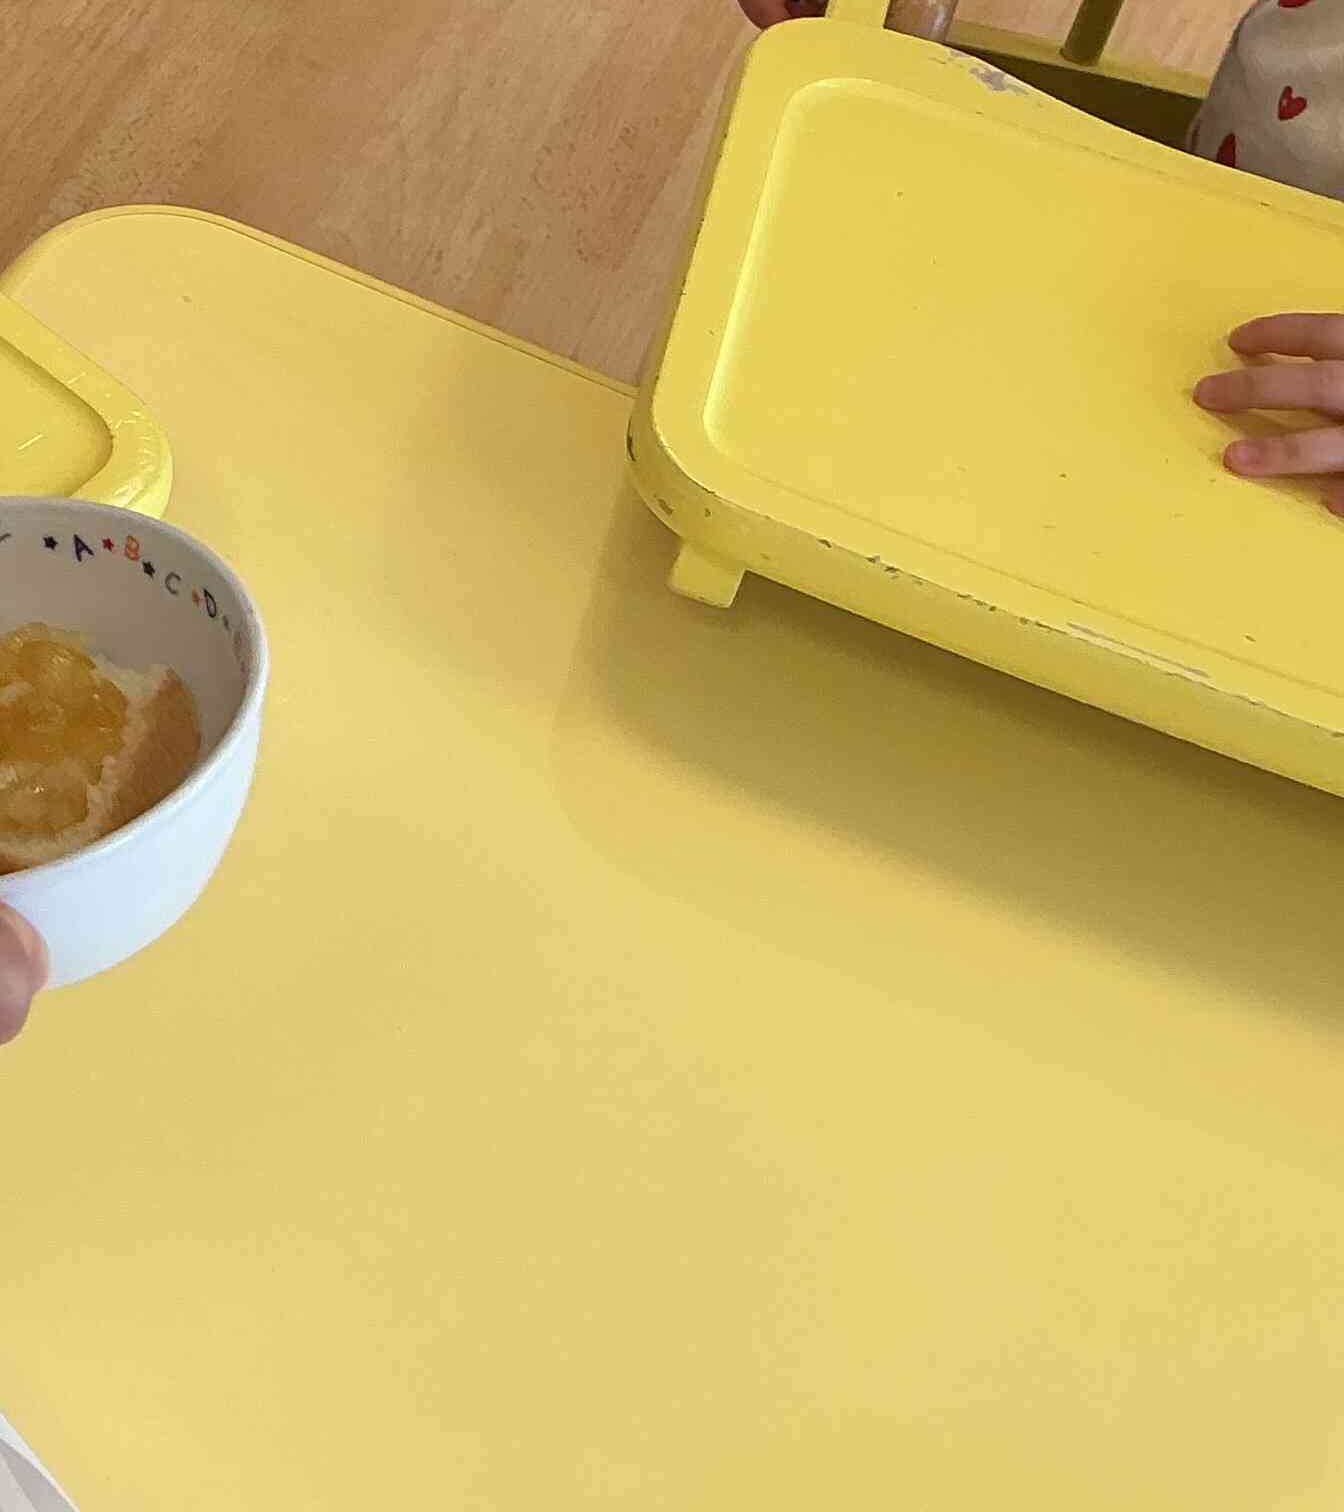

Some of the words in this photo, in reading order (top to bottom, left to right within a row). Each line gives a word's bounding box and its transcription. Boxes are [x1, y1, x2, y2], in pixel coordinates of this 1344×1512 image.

[73, 534, 95, 562] A
[124, 535, 140, 561] B
[164, 572, 181, 596] C
[203, 589, 218, 618] D
